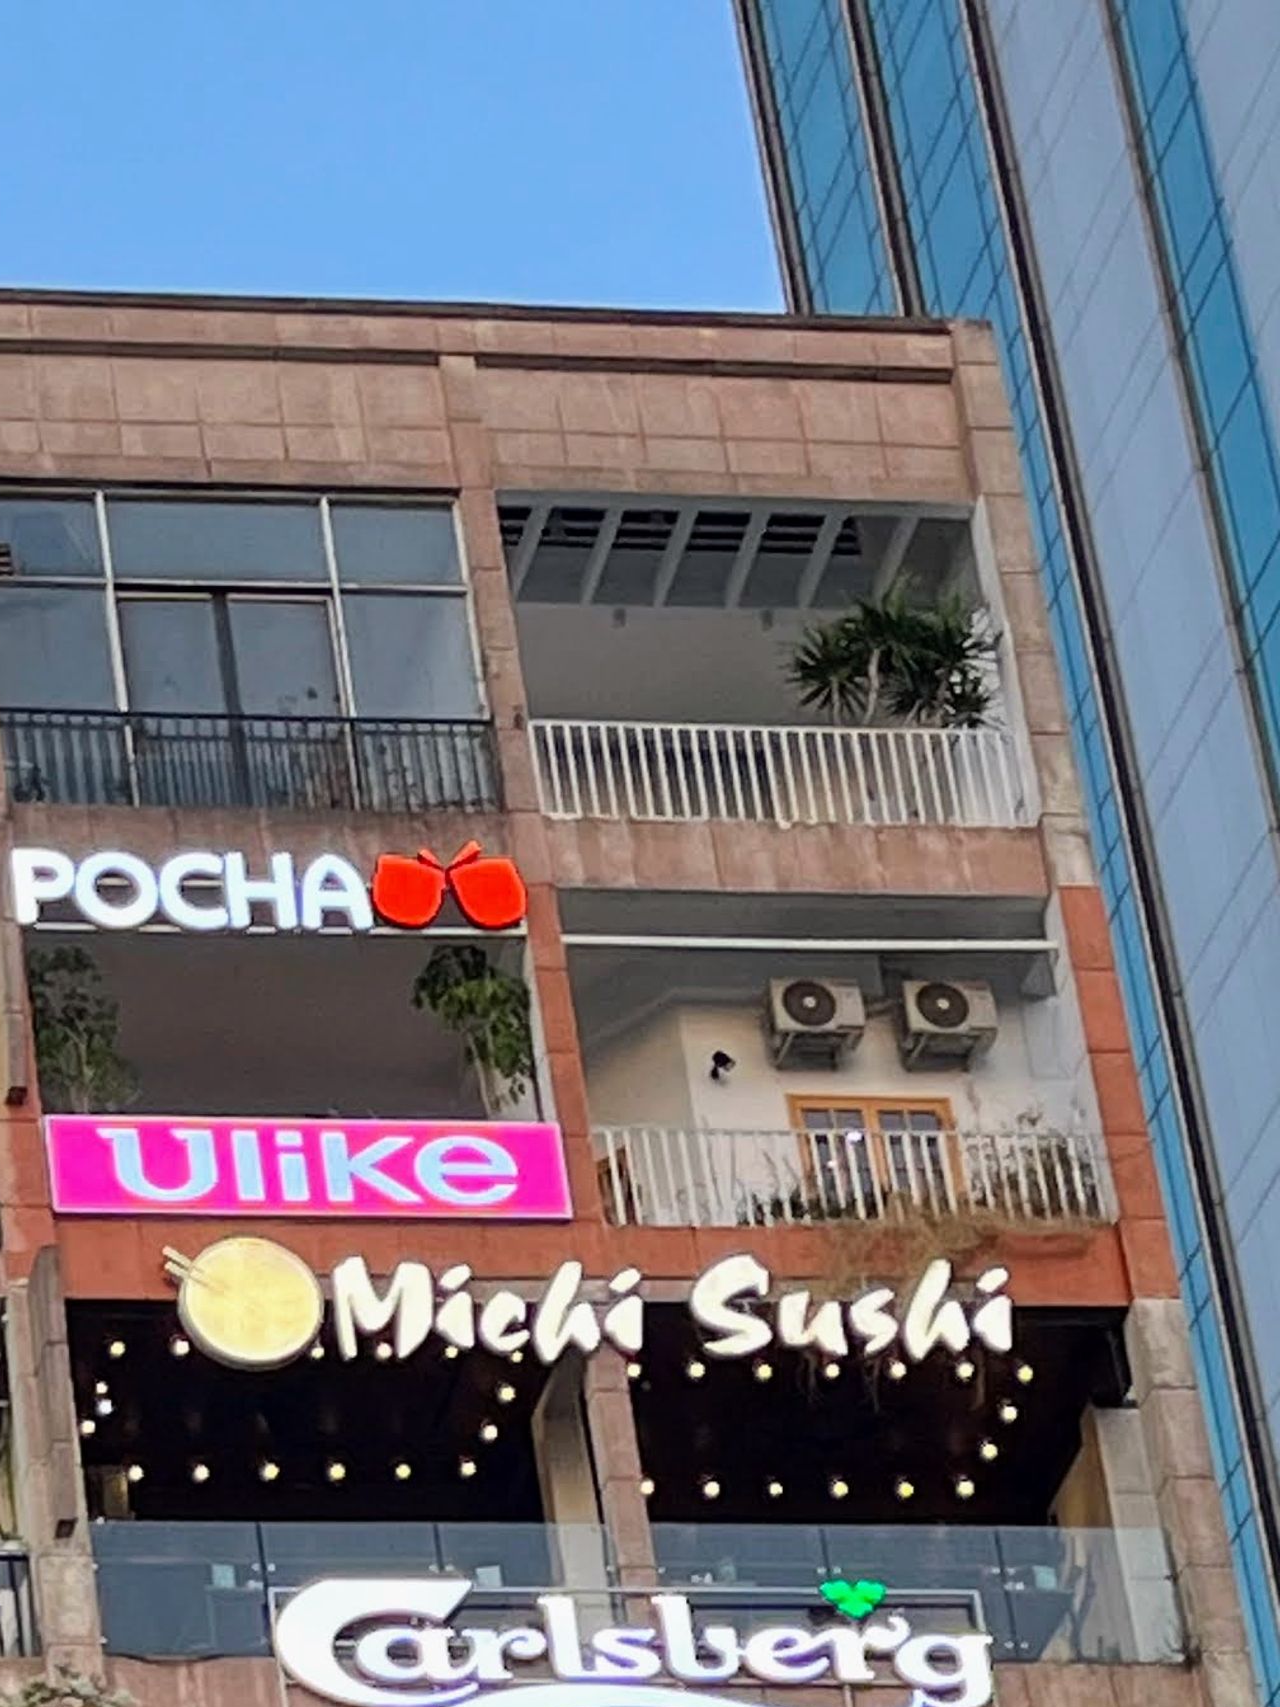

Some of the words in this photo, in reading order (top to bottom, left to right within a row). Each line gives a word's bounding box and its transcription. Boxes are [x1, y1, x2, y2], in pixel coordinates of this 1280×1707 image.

[13, 847, 376, 930] POCHA
[332, 1255, 643, 1363] Michi
[690, 1254, 1013, 1358] Sushi
